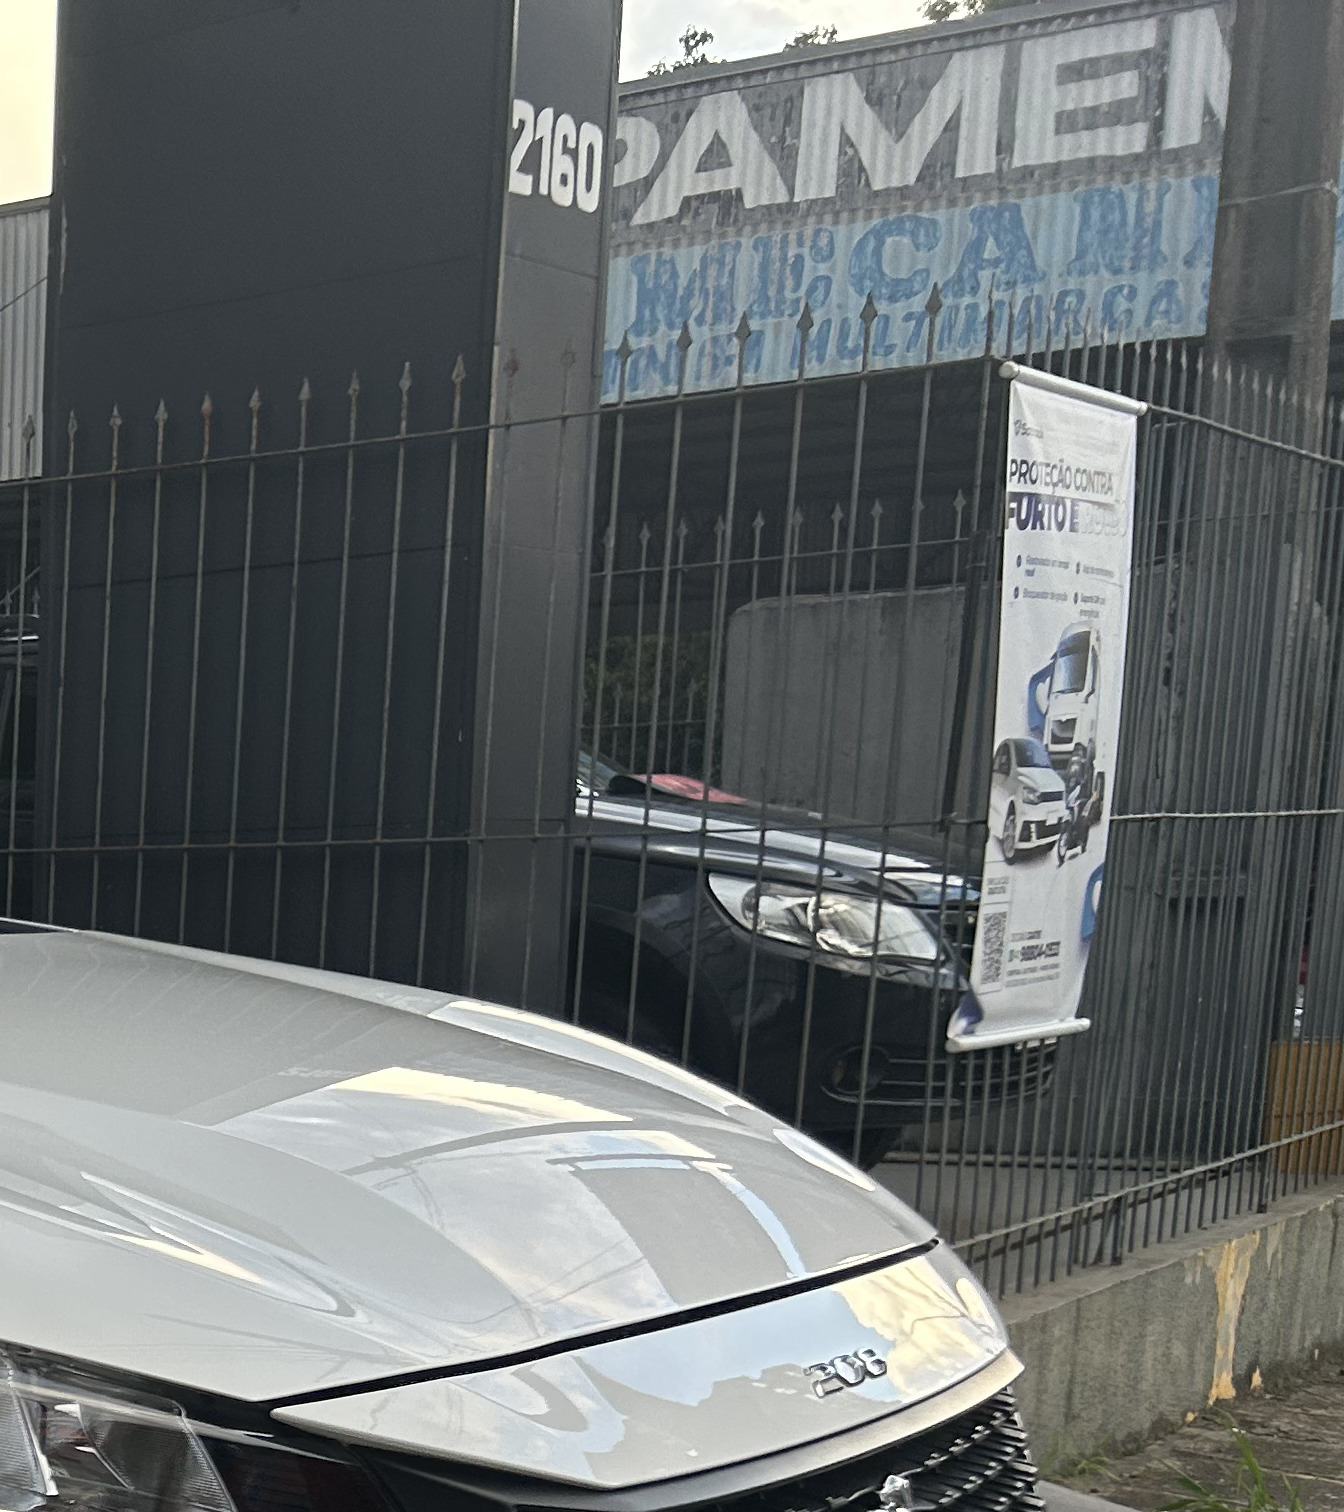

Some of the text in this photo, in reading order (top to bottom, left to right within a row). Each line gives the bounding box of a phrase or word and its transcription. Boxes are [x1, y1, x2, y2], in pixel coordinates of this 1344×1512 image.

[508, 98, 603, 214] 2160
[1009, 457, 1072, 495] PROTEÇÃO
[1006, 491, 1067, 532] FURTO
[803, 1348, 887, 1398] 208
